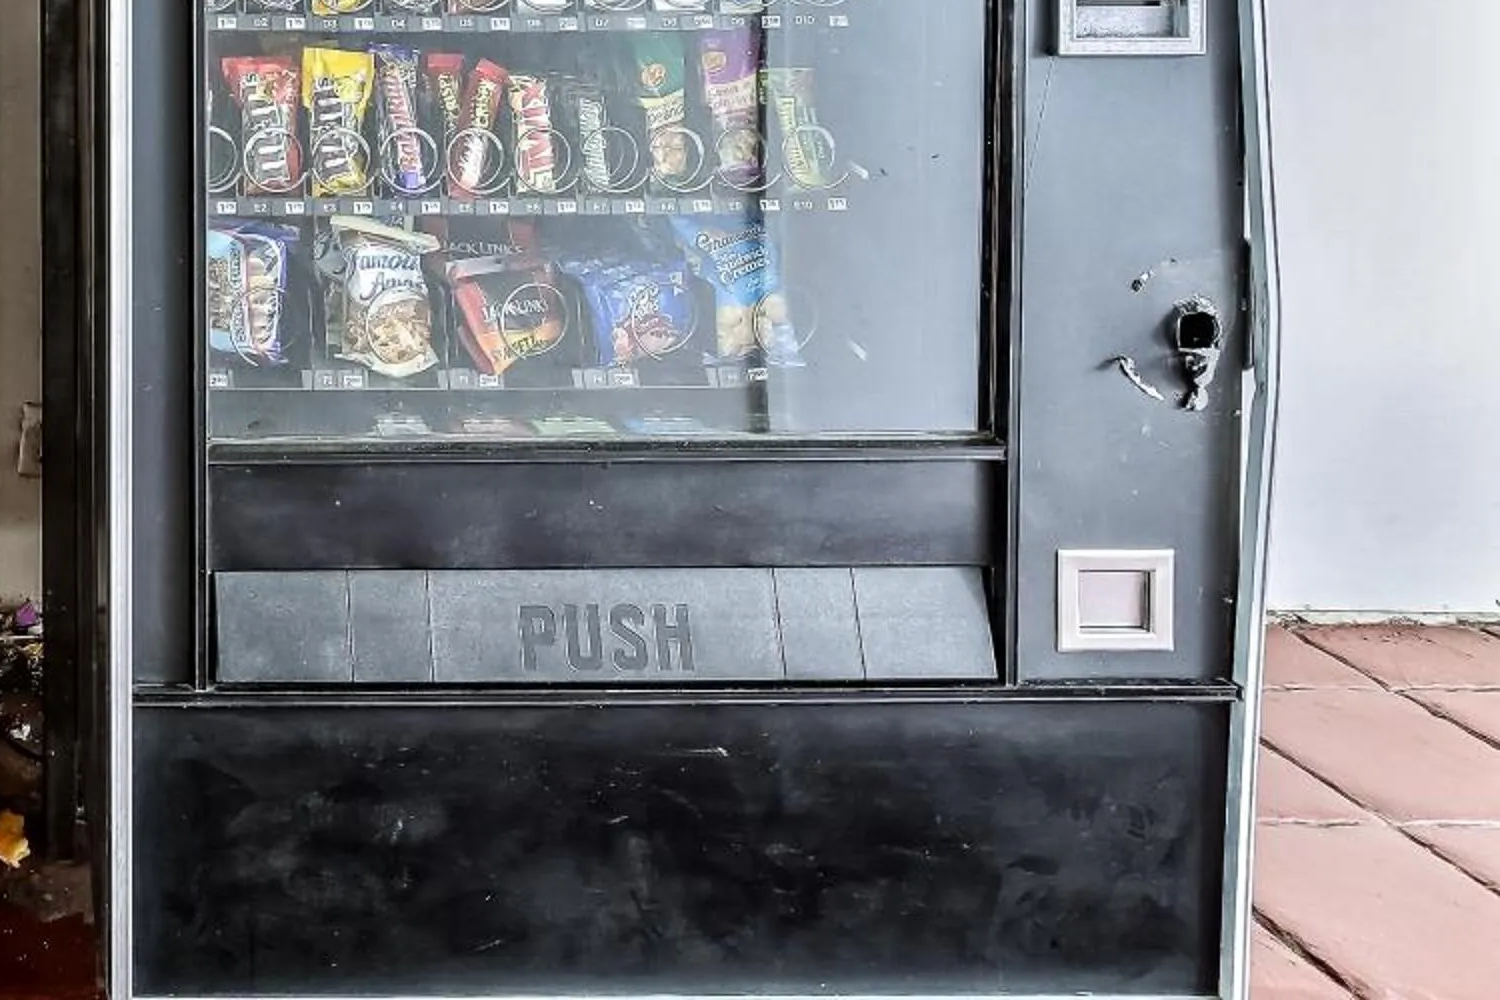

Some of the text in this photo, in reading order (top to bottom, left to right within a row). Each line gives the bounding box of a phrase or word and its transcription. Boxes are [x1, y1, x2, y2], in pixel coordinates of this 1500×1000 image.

[795, 15, 816, 26] D10
[348, 253, 419, 274] Famous
[517, 603, 695, 671] PUSH
